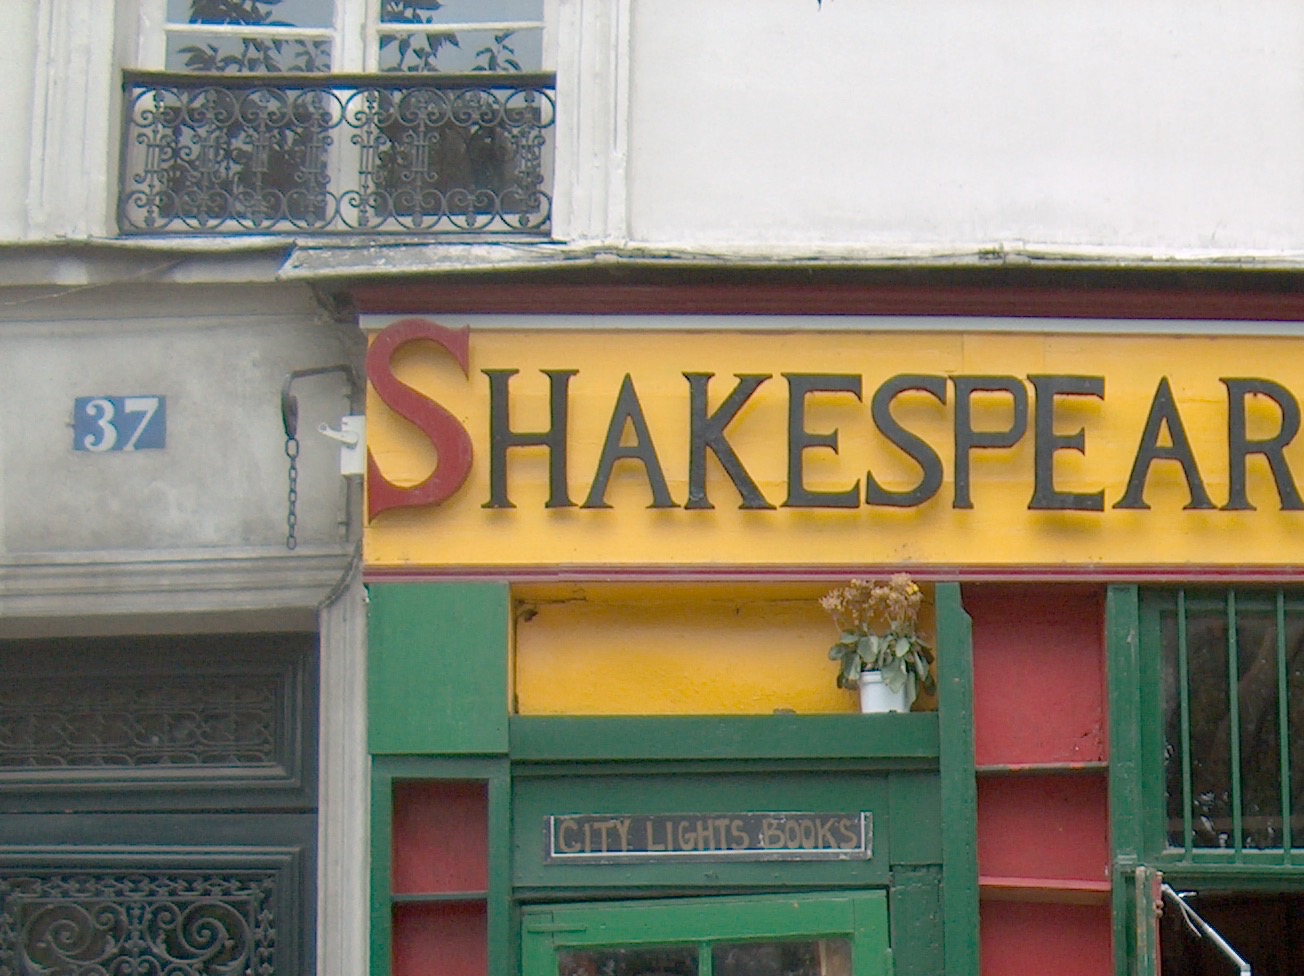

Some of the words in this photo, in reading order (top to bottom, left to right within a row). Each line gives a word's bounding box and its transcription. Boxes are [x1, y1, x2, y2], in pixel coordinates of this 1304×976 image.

[84, 397, 159, 451] 37
[558, 818, 631, 852] CITY
[647, 817, 749, 851] LIGHTS
[761, 817, 858, 850] BOOKS
